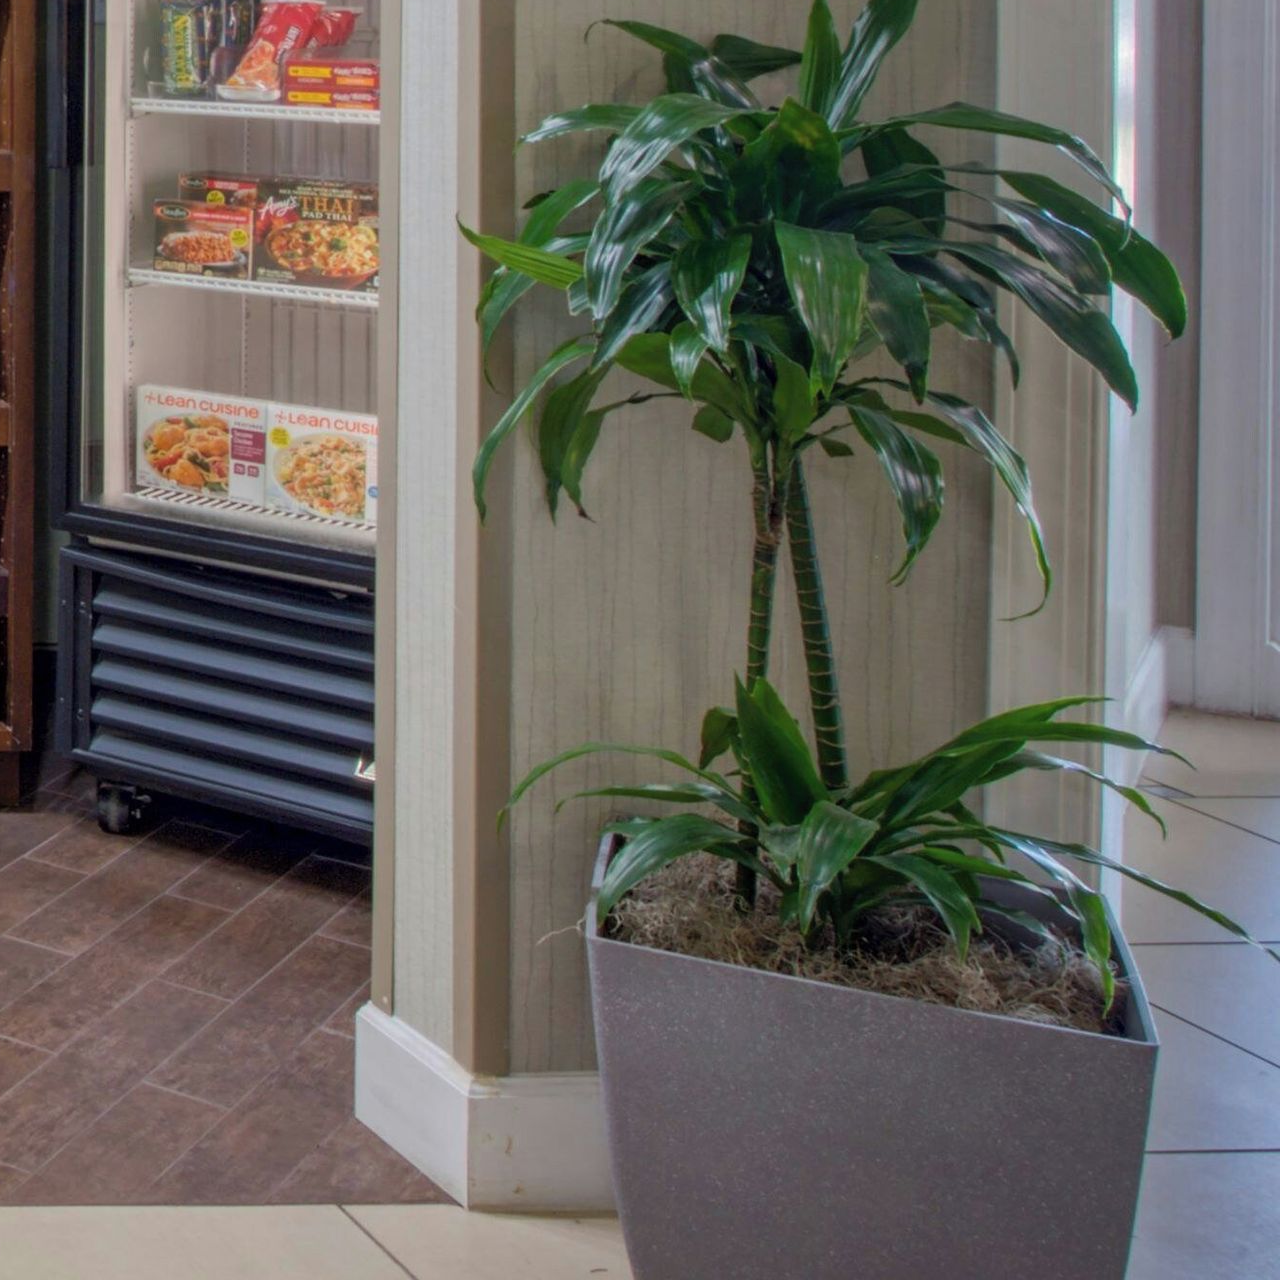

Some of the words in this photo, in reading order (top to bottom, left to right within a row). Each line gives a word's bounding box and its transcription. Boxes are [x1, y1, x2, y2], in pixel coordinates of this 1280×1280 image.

[258, 196, 299, 220] Amy's
[300, 195, 355, 213] THAI
[324, 211, 352, 222] THAI
